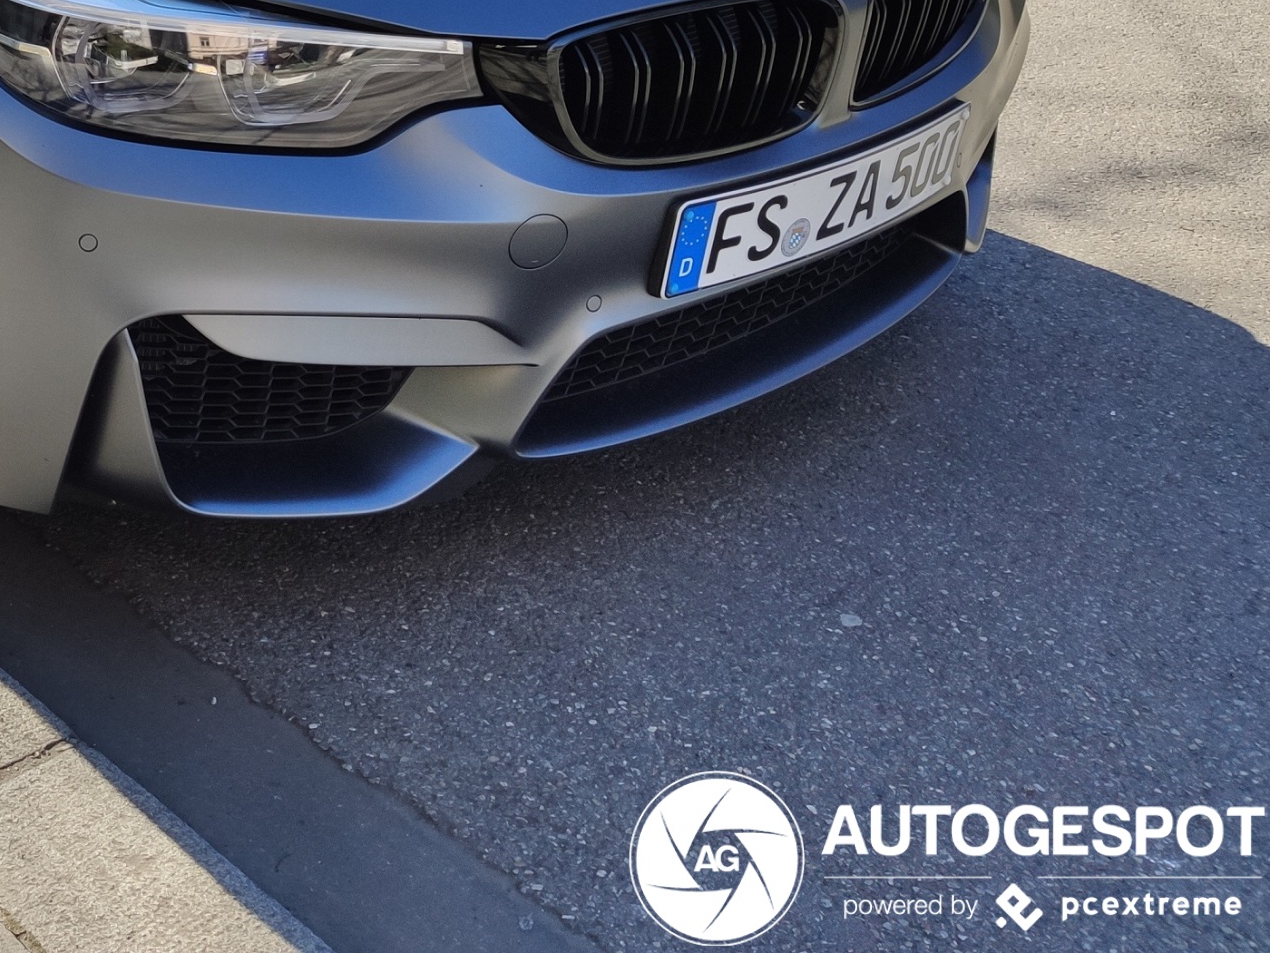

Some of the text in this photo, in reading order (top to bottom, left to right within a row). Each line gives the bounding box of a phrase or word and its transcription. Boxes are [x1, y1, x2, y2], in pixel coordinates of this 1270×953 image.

[705, 194, 789, 275] FS
[815, 159, 882, 242] ZA
[885, 120, 961, 211] 500
[678, 256, 693, 278] D
